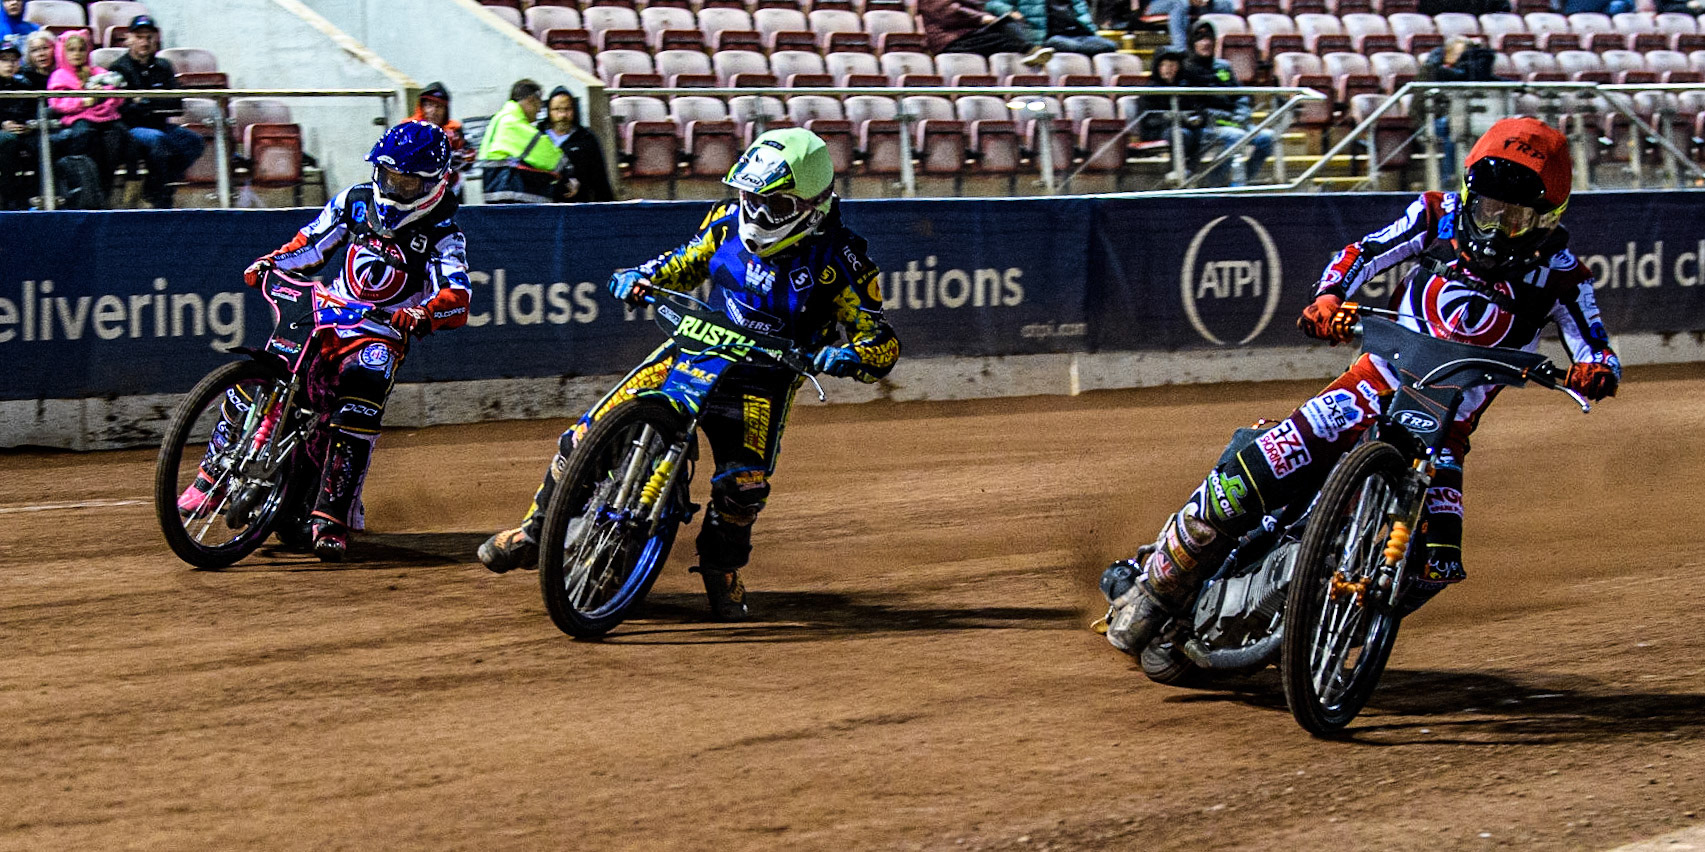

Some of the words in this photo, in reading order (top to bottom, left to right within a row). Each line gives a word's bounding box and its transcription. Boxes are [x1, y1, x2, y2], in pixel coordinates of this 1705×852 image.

[1197, 260, 1262, 299] ATPI
[1579, 241, 1664, 289] orld
[467, 269, 600, 327] Class
[677, 314, 756, 357] RUSTY
[1323, 395, 1347, 428] DXB
[1401, 412, 1434, 428] FRP
[1220, 499, 1235, 517] OIL
